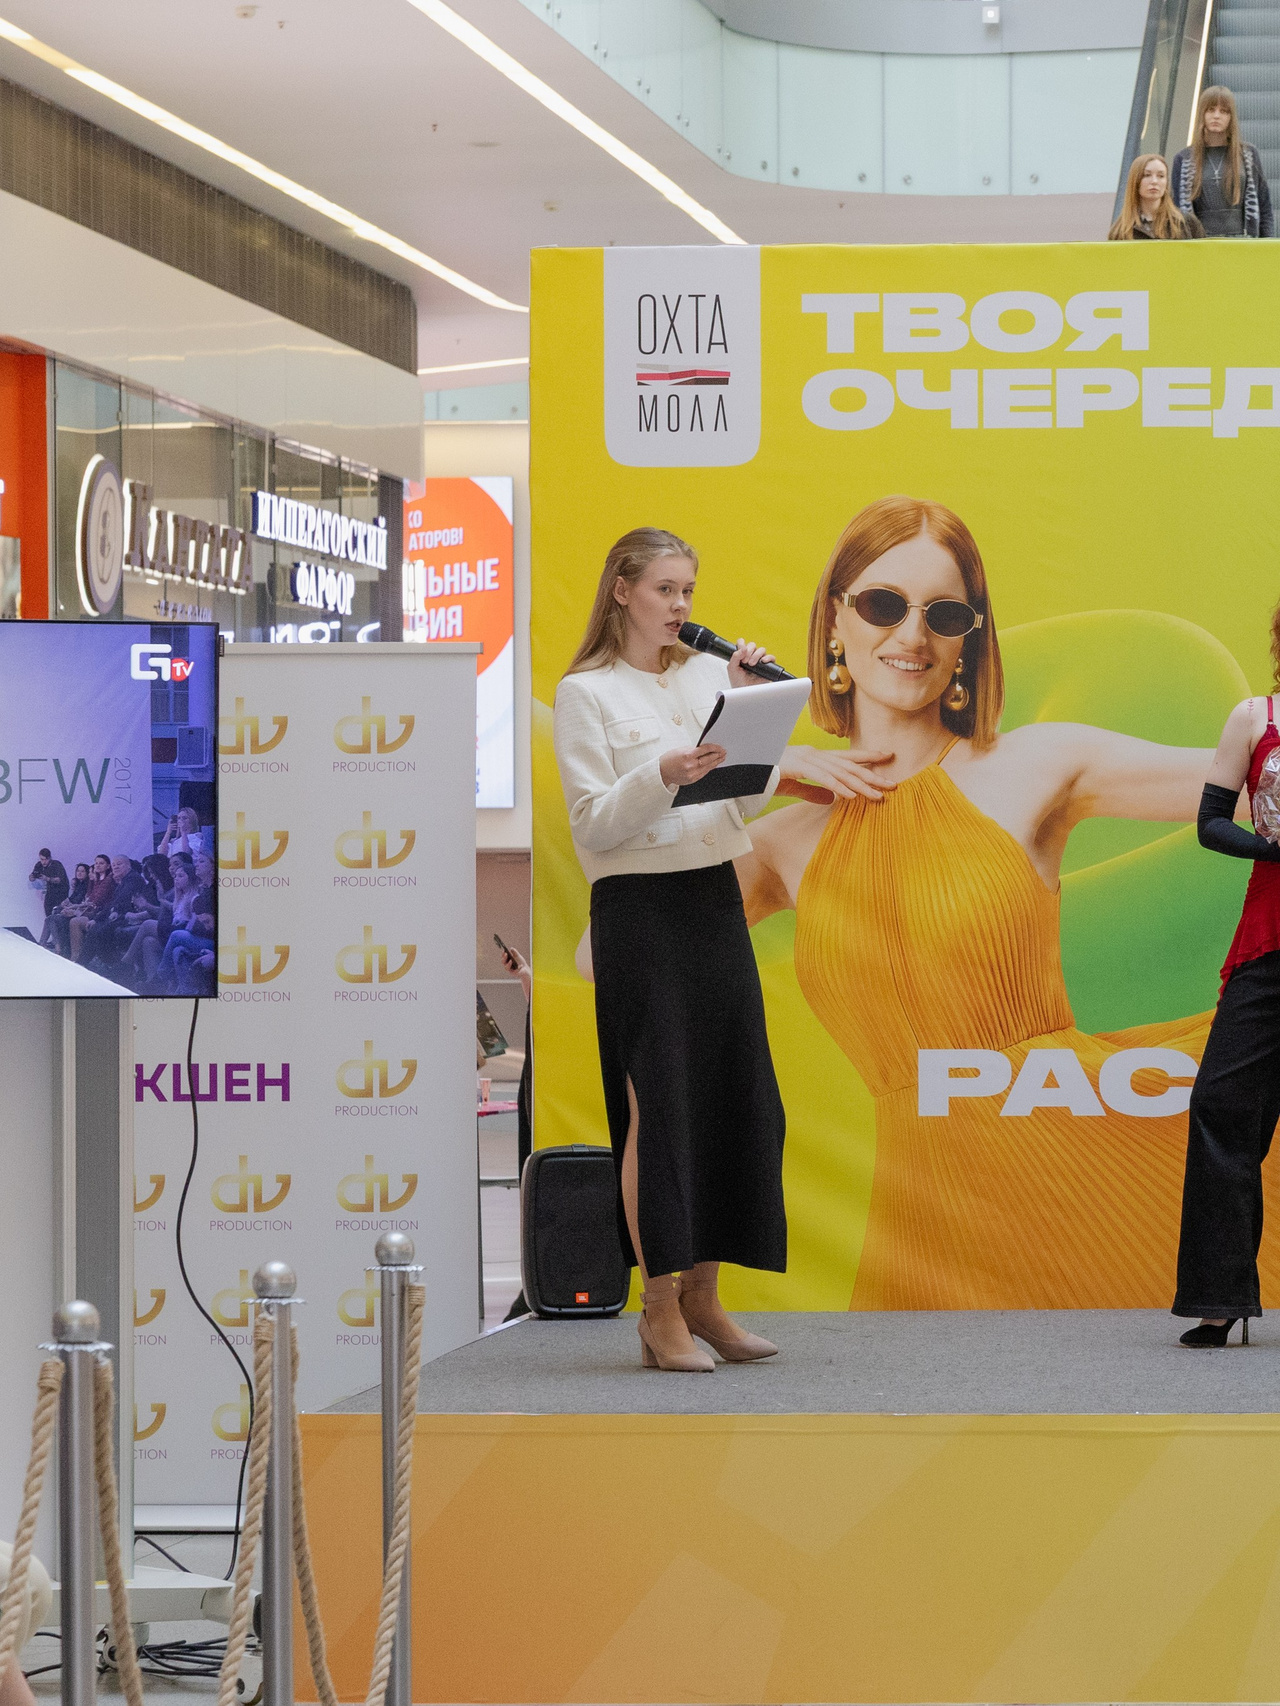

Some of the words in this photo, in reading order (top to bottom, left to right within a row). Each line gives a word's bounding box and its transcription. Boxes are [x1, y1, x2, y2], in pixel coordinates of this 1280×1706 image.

[637, 293, 729, 355] ОХТА
[801, 290, 1150, 354] ТВОЯ
[638, 393, 728, 433] МОЛЛ
[255, 490, 388, 570] ИМПЕРАТОРСКИЙ
[424, 557, 500, 598] ЬНЫЕ
[295, 561, 355, 615] ФАРФОР
[218, 762, 289, 773] ODUCTION
[332, 761, 416, 772] PRODUCTION
[114, 757, 132, 805] 2017
[217, 876, 290, 888] RODUCTION
[333, 876, 417, 887] PRODUCTION
[208, 991, 290, 1002] RODUCTION
[334, 990, 418, 1002] PRODUCTION
[134, 1063, 291, 1102] КШЕН
[334, 1105, 418, 1116] PRODUCTION
[209, 1220, 292, 1231] PRODUCTION
[335, 1220, 419, 1231] PRODUCTION
[336, 1335, 382, 1346] PRODU
